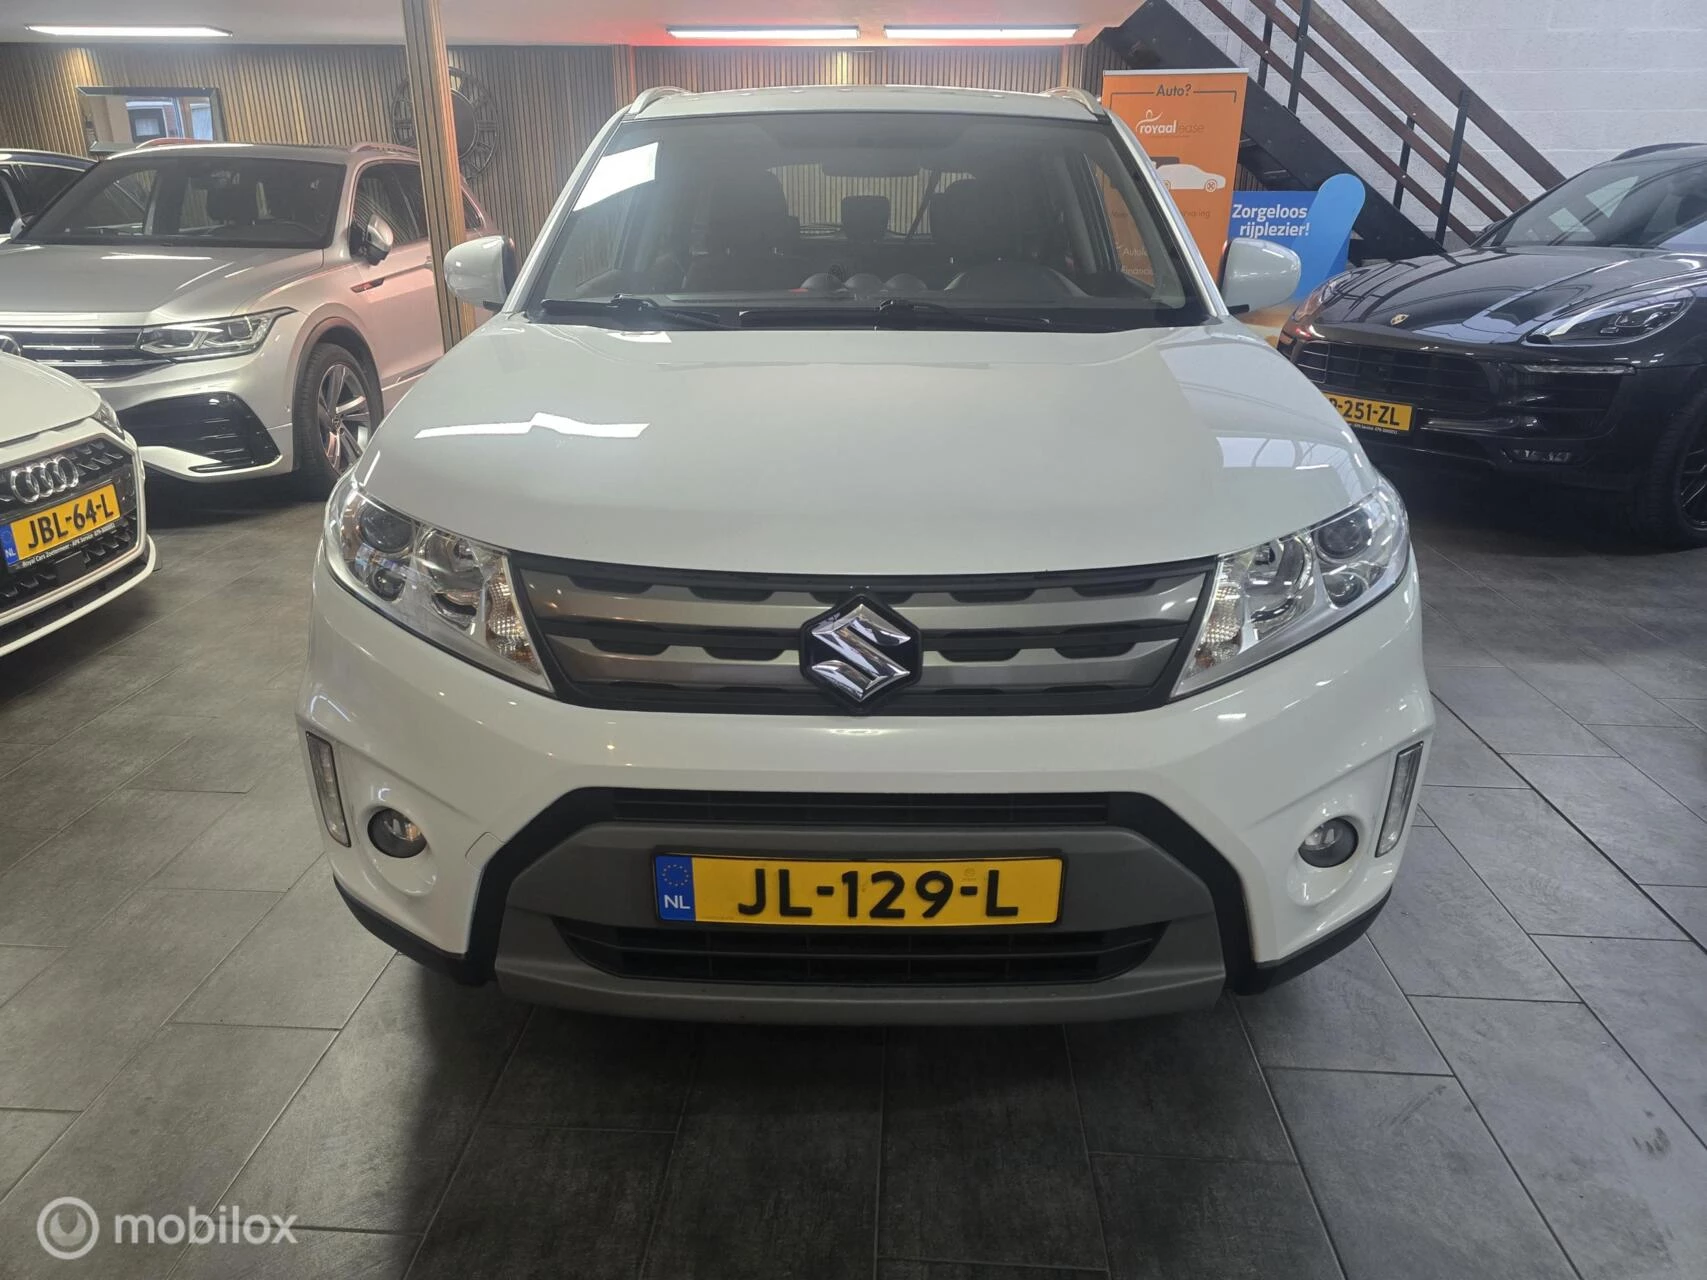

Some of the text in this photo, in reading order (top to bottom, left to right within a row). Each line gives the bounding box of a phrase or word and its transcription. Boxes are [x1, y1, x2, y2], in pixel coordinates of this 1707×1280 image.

[1156, 83, 1192, 97] Auto?
[1231, 203, 1308, 222] Zorgeloos
[1239, 221, 1311, 239] rijplezier!
[28, 493, 114, 549] JBL-64-L
[5, 547, 17, 558] NL
[663, 894, 691, 910] NL
[737, 868, 1019, 919] JL-129-L
